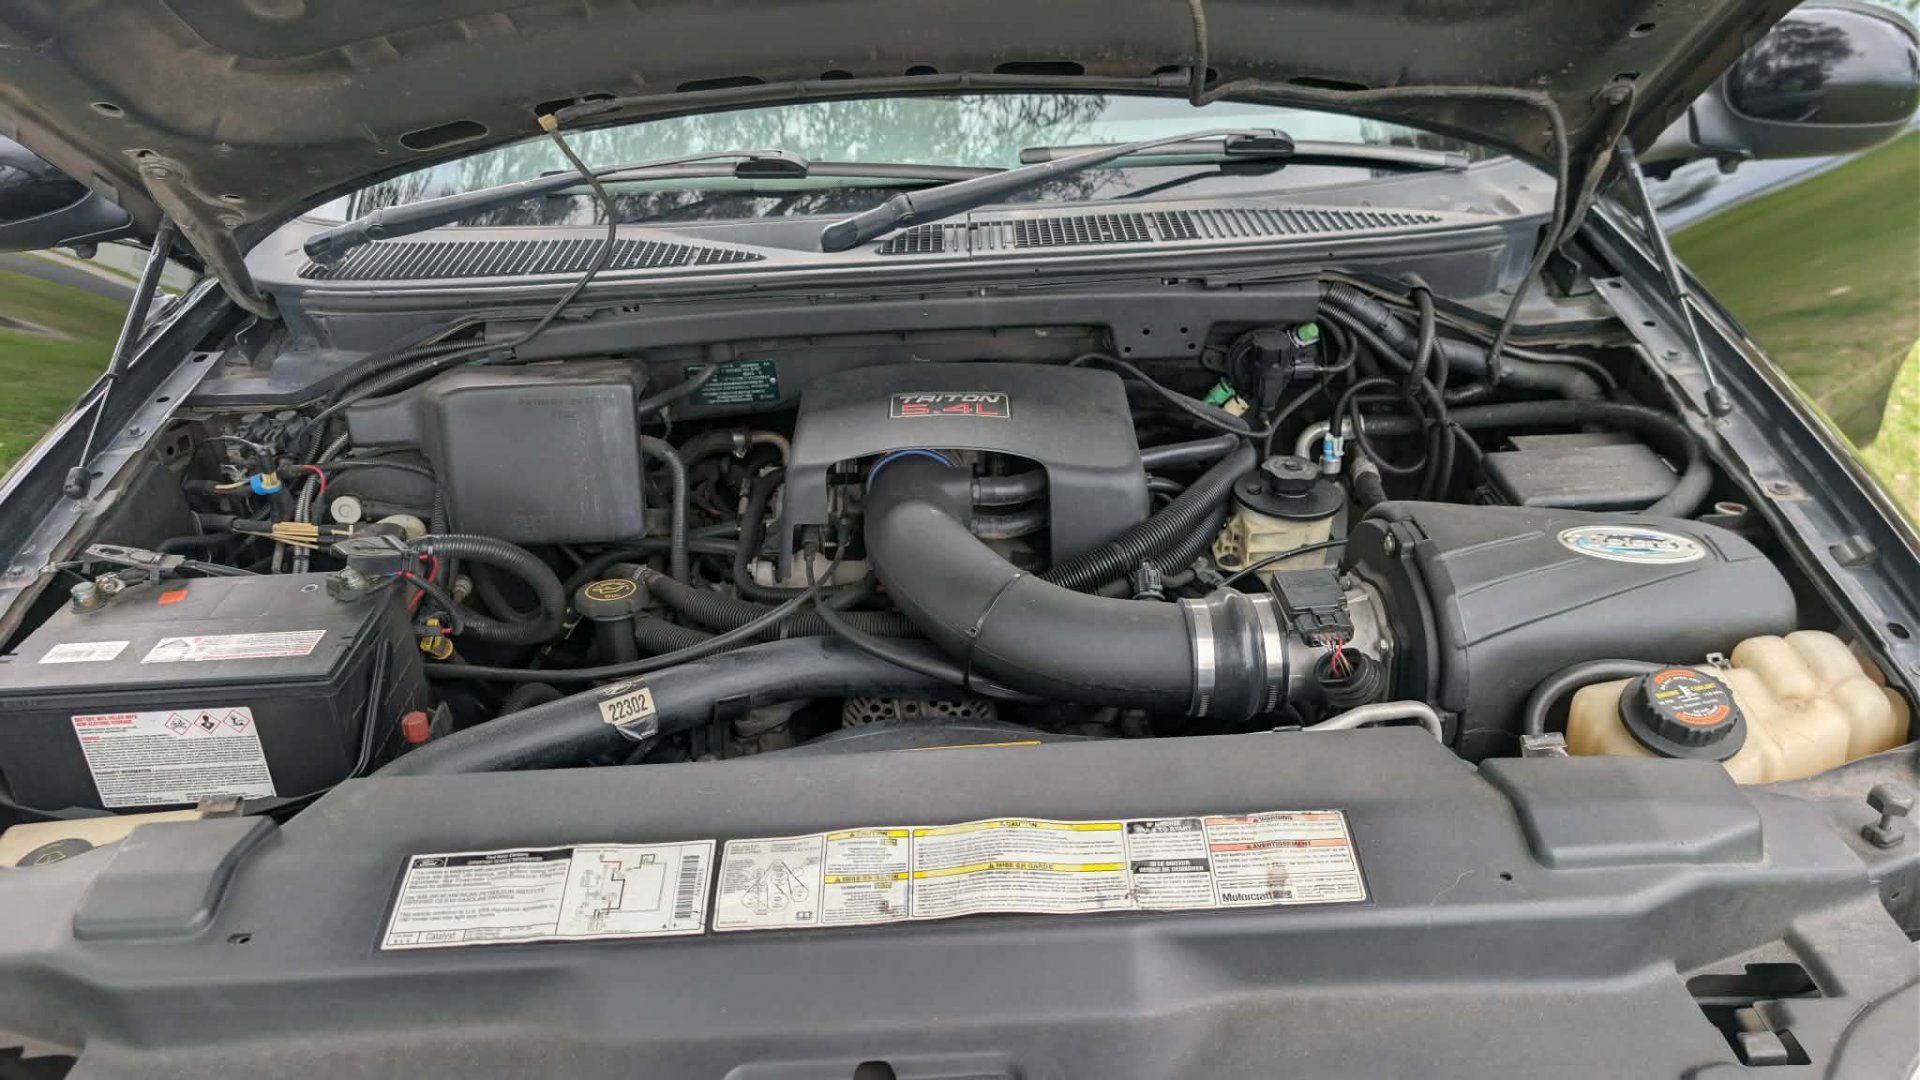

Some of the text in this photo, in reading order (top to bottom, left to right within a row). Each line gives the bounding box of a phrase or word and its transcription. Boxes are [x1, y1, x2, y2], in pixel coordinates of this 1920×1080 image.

[900, 394, 1000, 403] TRITON
[901, 403, 998, 415] 5.4L
[608, 694, 648, 722] 22302
[1006, 820, 1037, 828] CAUN
[1221, 890, 1273, 902] Motorcraft
[425, 931, 457, 943] Catalyst
